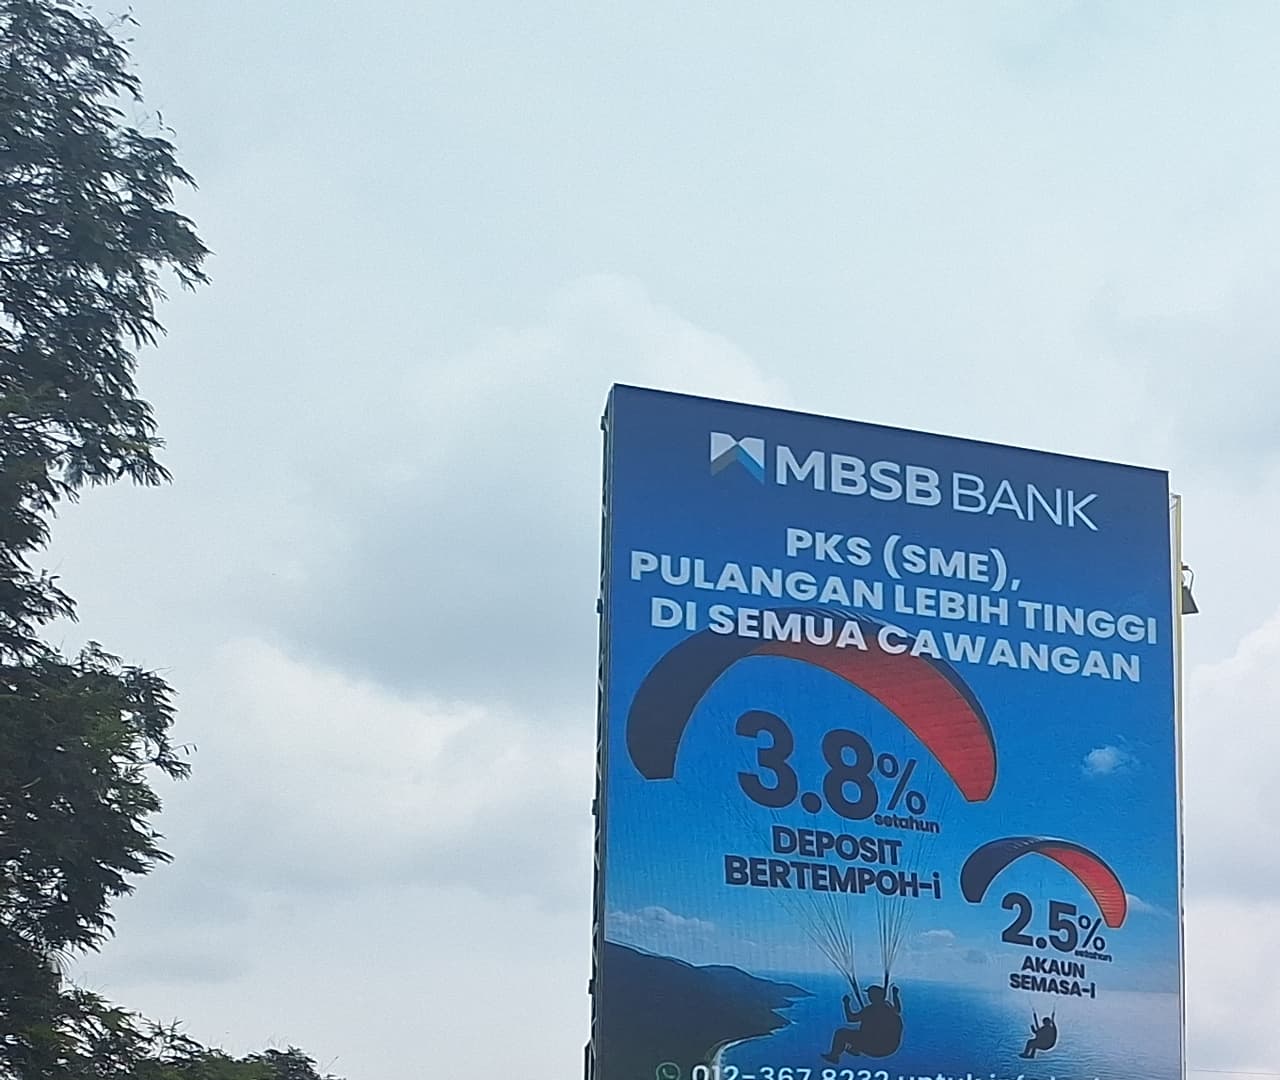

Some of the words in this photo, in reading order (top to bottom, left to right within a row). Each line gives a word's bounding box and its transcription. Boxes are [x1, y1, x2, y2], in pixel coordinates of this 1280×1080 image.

[775, 445, 942, 507] MBSB
[952, 472, 1099, 531] BANK
[786, 527, 872, 567] PKS
[882, 534, 1021, 592] (SME),
[630, 550, 884, 611] PULANGAN
[894, 584, 1009, 627] LEBIH
[1017, 599, 1157, 645] TINGGI
[651, 597, 697, 632] DI
[708, 604, 869, 652] SEMUA
[877, 624, 1141, 683] CAWANGAN
[735, 709, 927, 821] 3.8%
[771, 824, 903, 867] DEPOSIT
[874, 812, 941, 834] setahun
[723, 853, 943, 900] BERTEMPOH-i
[1000, 891, 1107, 954] 2.5%
[1021, 955, 1086, 980] AKAUN
